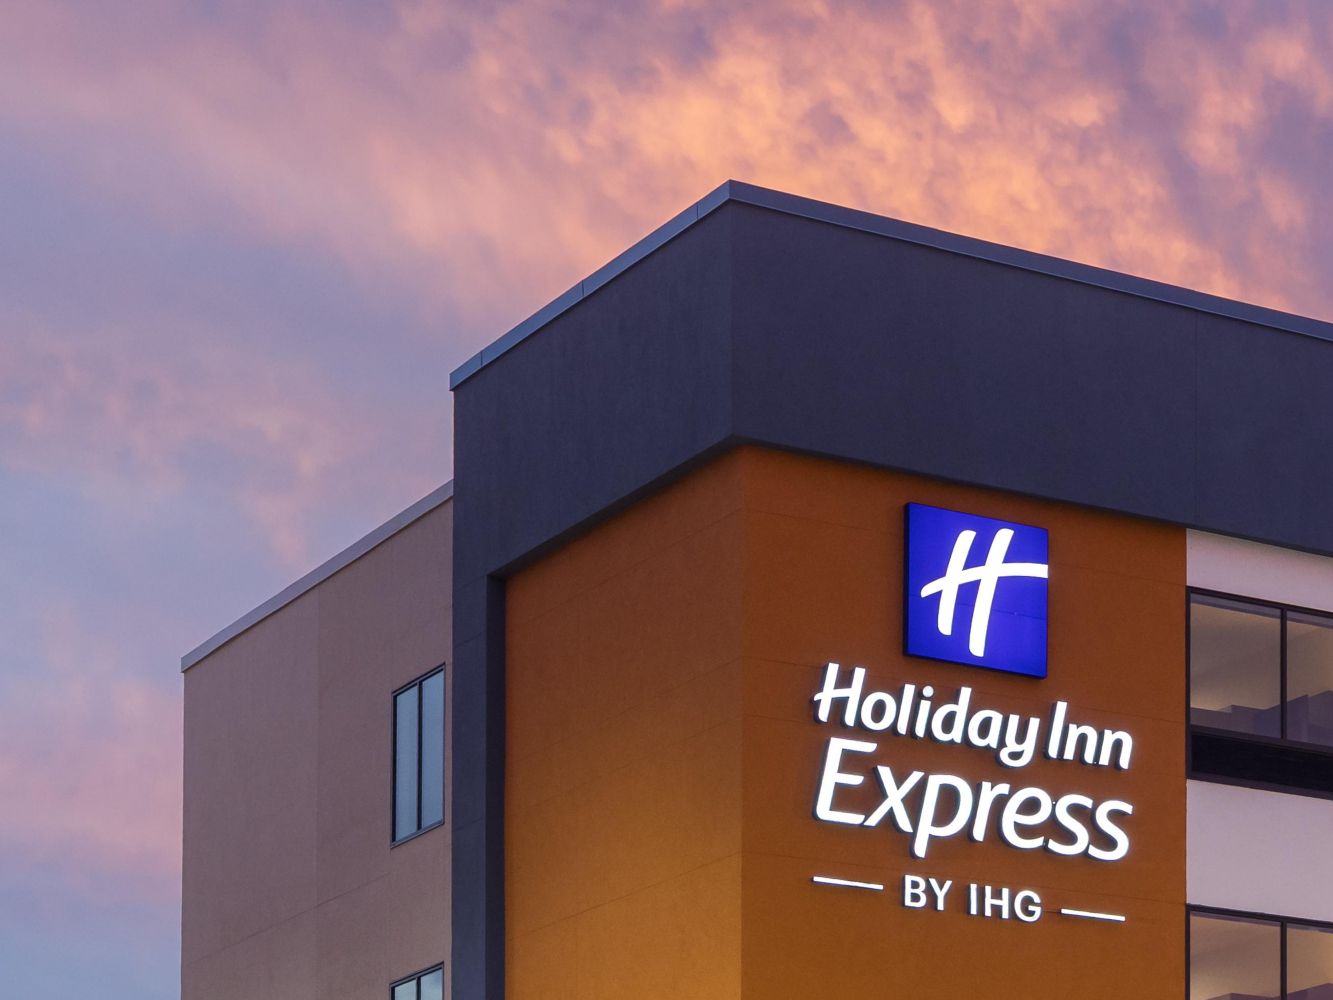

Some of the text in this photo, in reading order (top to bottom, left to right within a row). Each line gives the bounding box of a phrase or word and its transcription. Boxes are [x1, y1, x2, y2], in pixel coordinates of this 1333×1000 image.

[813, 662, 1133, 769] Holiday Inn
[815, 737, 1133, 860] Express
[904, 874, 1042, 922] BY IHG
